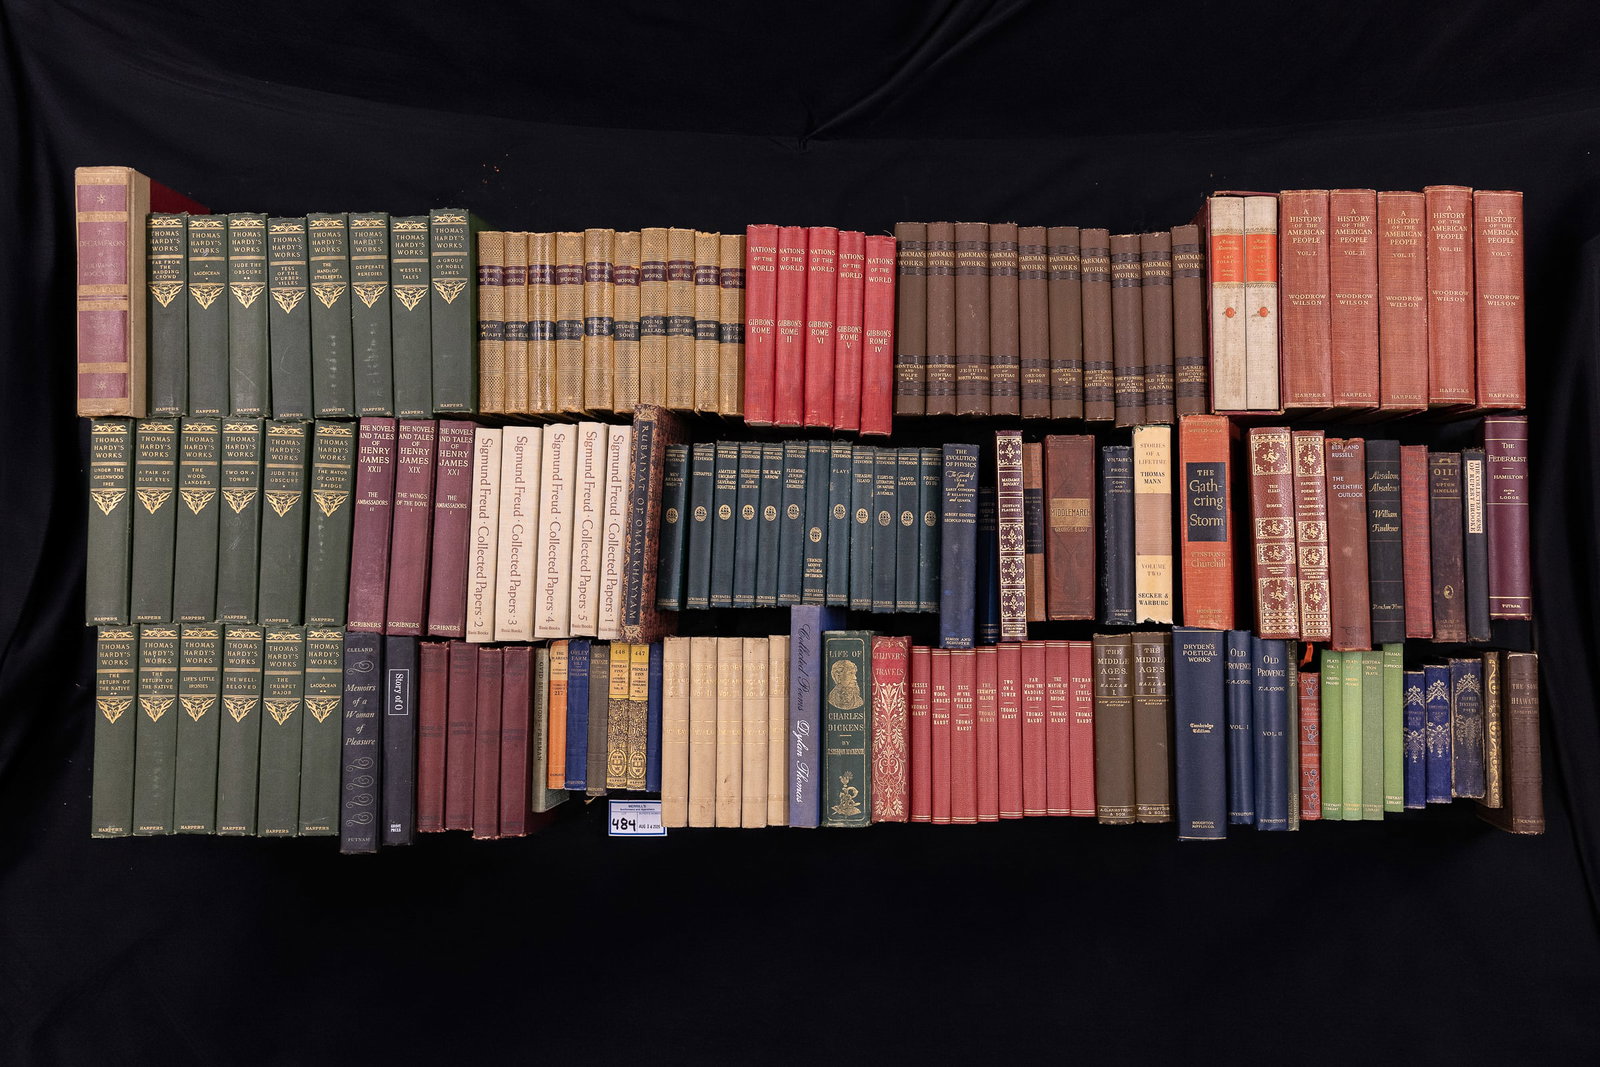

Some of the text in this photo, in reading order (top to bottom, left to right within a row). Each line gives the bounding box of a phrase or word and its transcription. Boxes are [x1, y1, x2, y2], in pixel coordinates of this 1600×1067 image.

[552, 433, 565, 480] Sigmund
[1190, 479, 1222, 493] Gath-
[550, 483, 562, 514] Freud
[1190, 514, 1224, 527] Storm
[1373, 510, 1397, 518] William
[474, 438, 493, 615] Sigmund Freud Collected Papers
[628, 426, 649, 620] RUBAIYAT OF OMAR KHAYYAM
[1372, 524, 1399, 532] Faulkner
[547, 520, 561, 574] Collected
[1191, 558, 1225, 567] Churchill
[544, 577, 558, 612] Papers
[1264, 655, 1279, 664] OLD
[796, 624, 811, 711] Collected Poems
[1258, 668, 1285, 677] PROVENCE
[394, 674, 403, 694] Story
[353, 698, 360, 706] of
[356, 724, 364, 734] of
[793, 720, 809, 804] Dylan Thomas
[612, 818, 636, 831] 484
